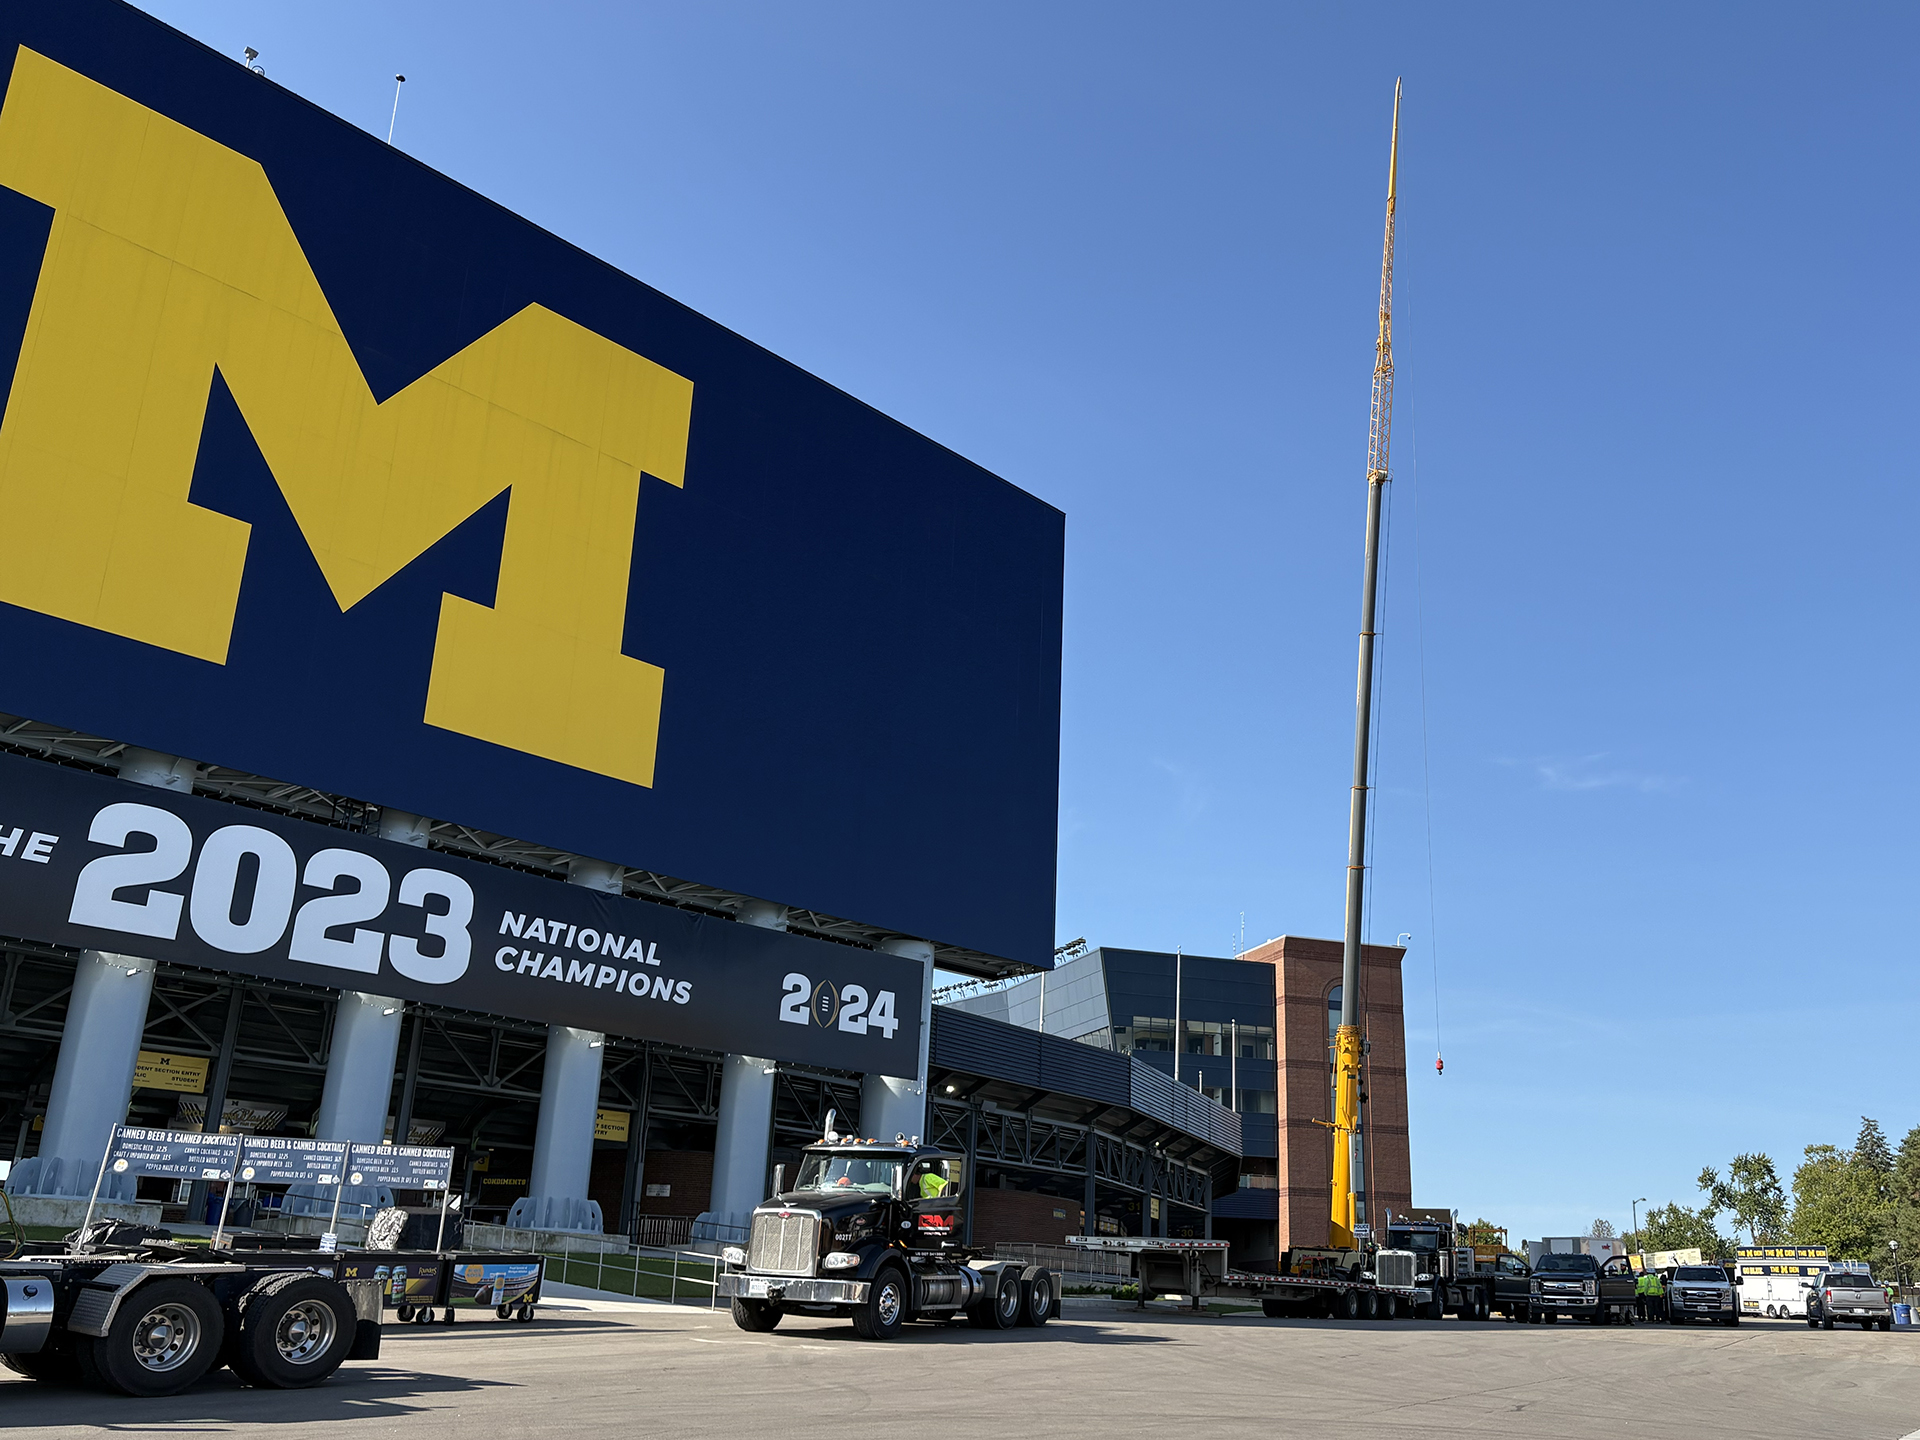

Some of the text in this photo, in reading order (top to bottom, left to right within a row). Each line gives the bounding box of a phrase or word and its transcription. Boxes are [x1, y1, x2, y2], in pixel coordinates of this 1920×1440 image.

[68, 802, 475, 985] 2023
[498, 910, 662, 967] NATIONAL
[494, 945, 693, 1006] CHAMPIONS
[154, 1067, 180, 1075] SECTION
[116, 1128, 238, 1146] CANNED BEER & CANNED COCKTAILS
[244, 1137, 346, 1153] CANNED BEER & CANNED COCKTAILS
[351, 1144, 451, 1159] CANNED BEER & CANNED COCKTAILS
[482, 1178, 527, 1186] CONDIMENTS
[1128, 1202, 1140, 1211] 31
[1181, 1229, 1194, 1237] 30
